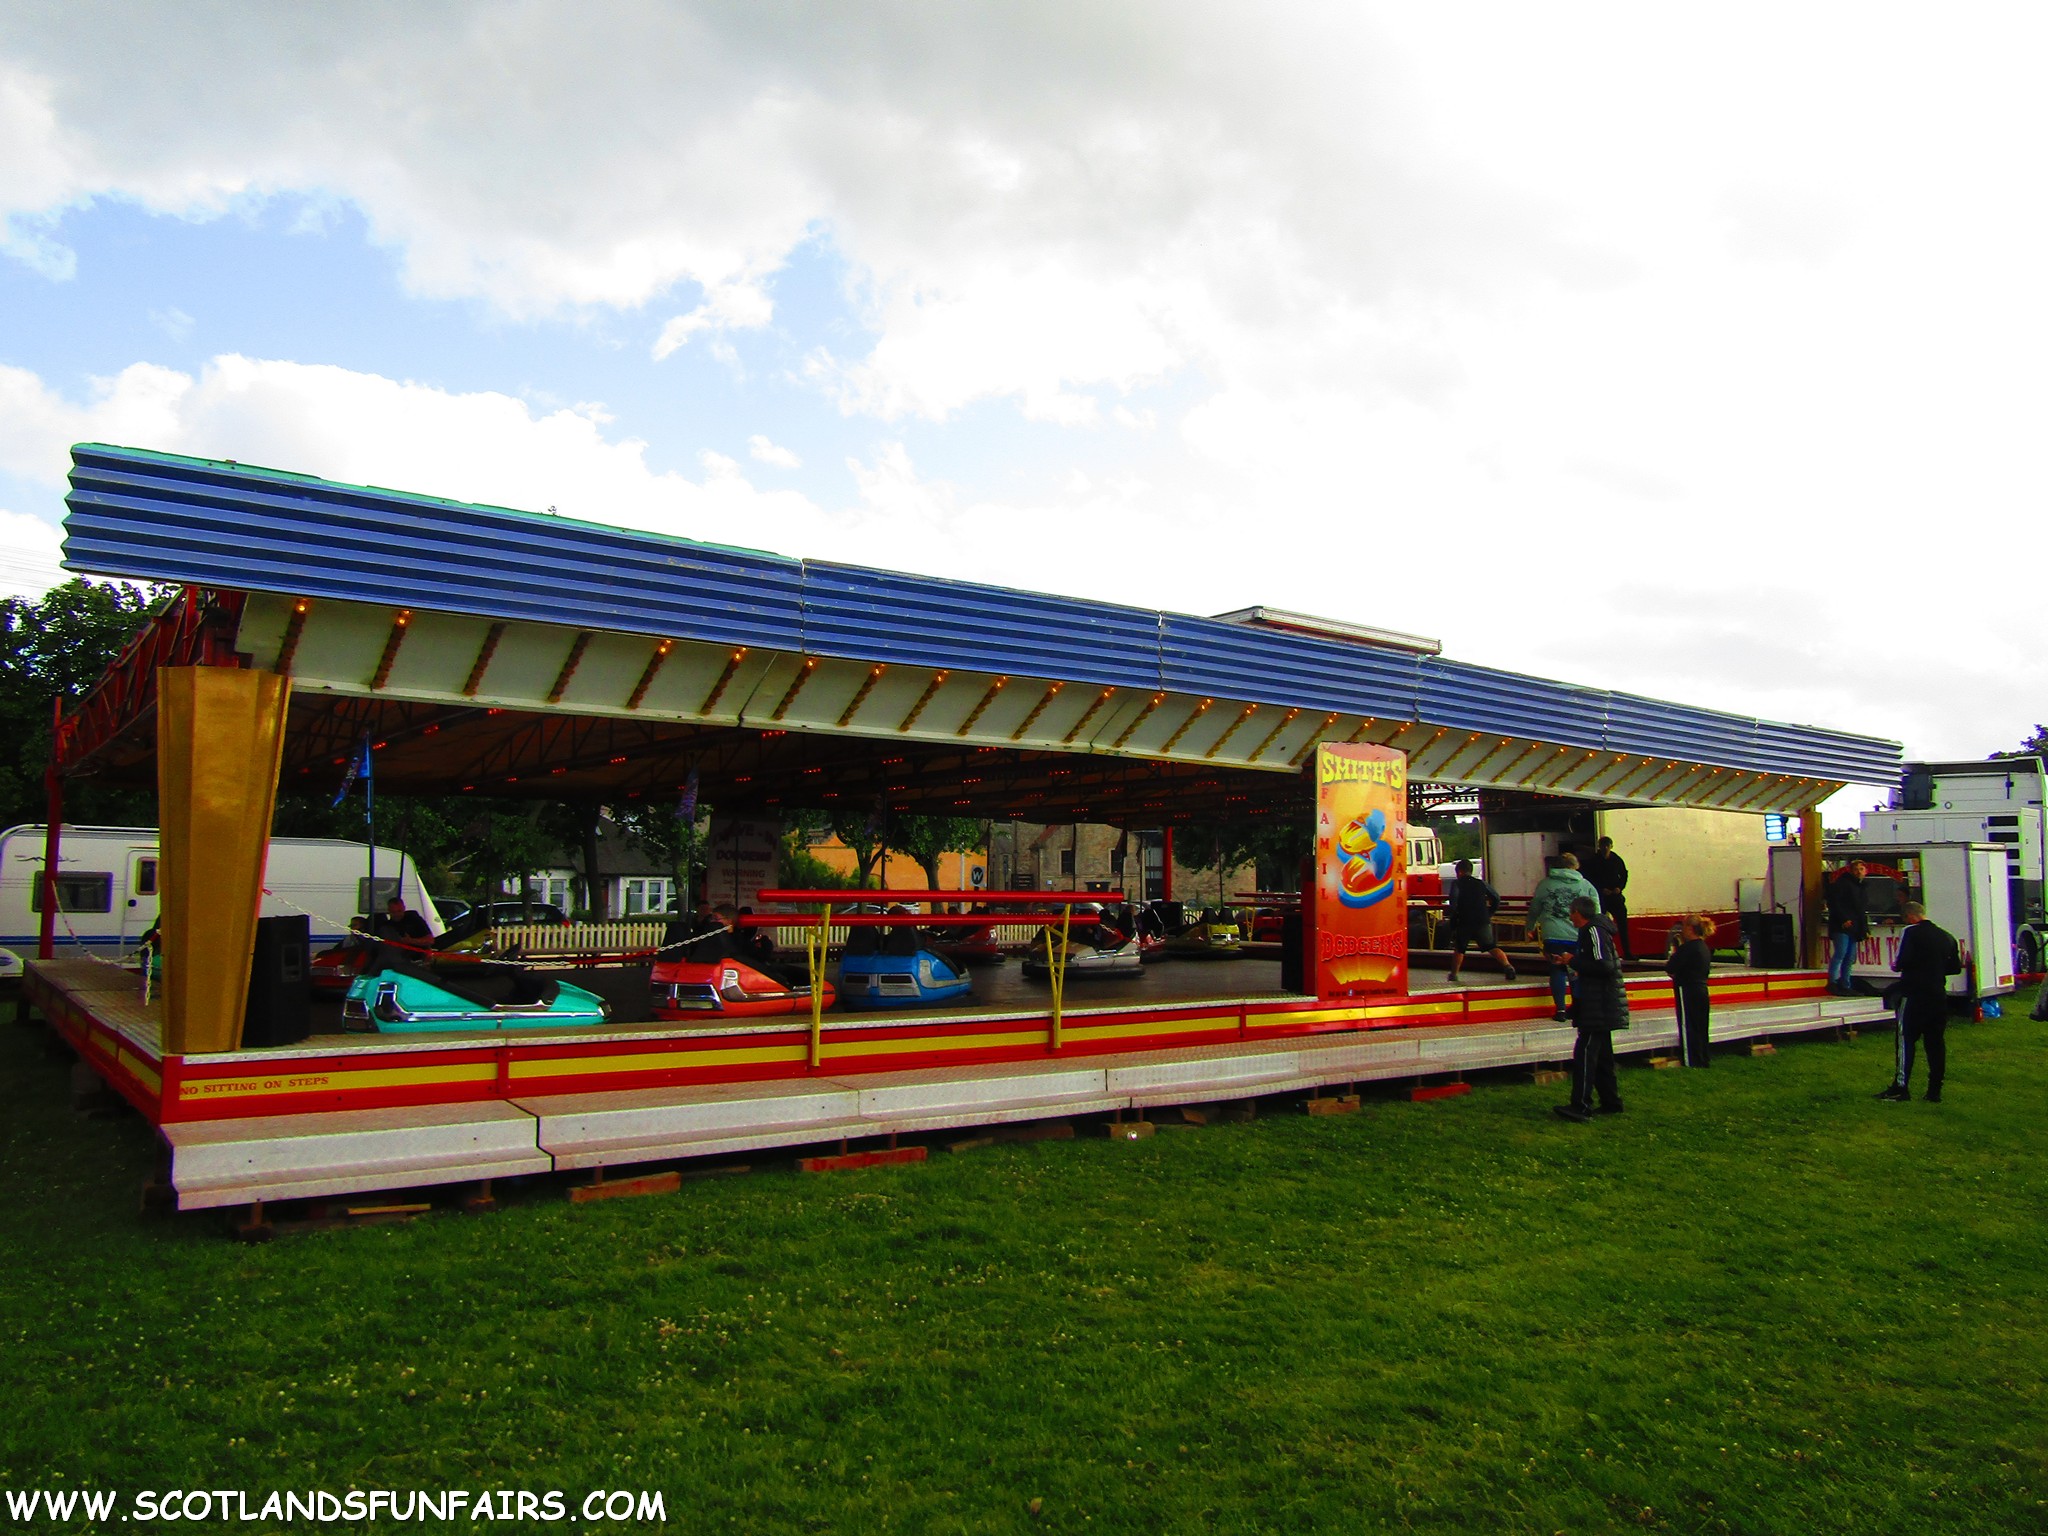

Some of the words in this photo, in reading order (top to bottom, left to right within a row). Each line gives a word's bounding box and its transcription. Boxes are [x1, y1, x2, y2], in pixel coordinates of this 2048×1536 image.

[1322, 751, 1402, 789] SMITH'S
[1320, 787, 1330, 926] FAMILY
[1395, 793, 1404, 926] FUNFAIRS
[180, 1087, 198, 1096] NO
[204, 1082, 257, 1093] SITTING
[264, 1080, 281, 1089] ON
[288, 1076, 329, 1087] STEPS
